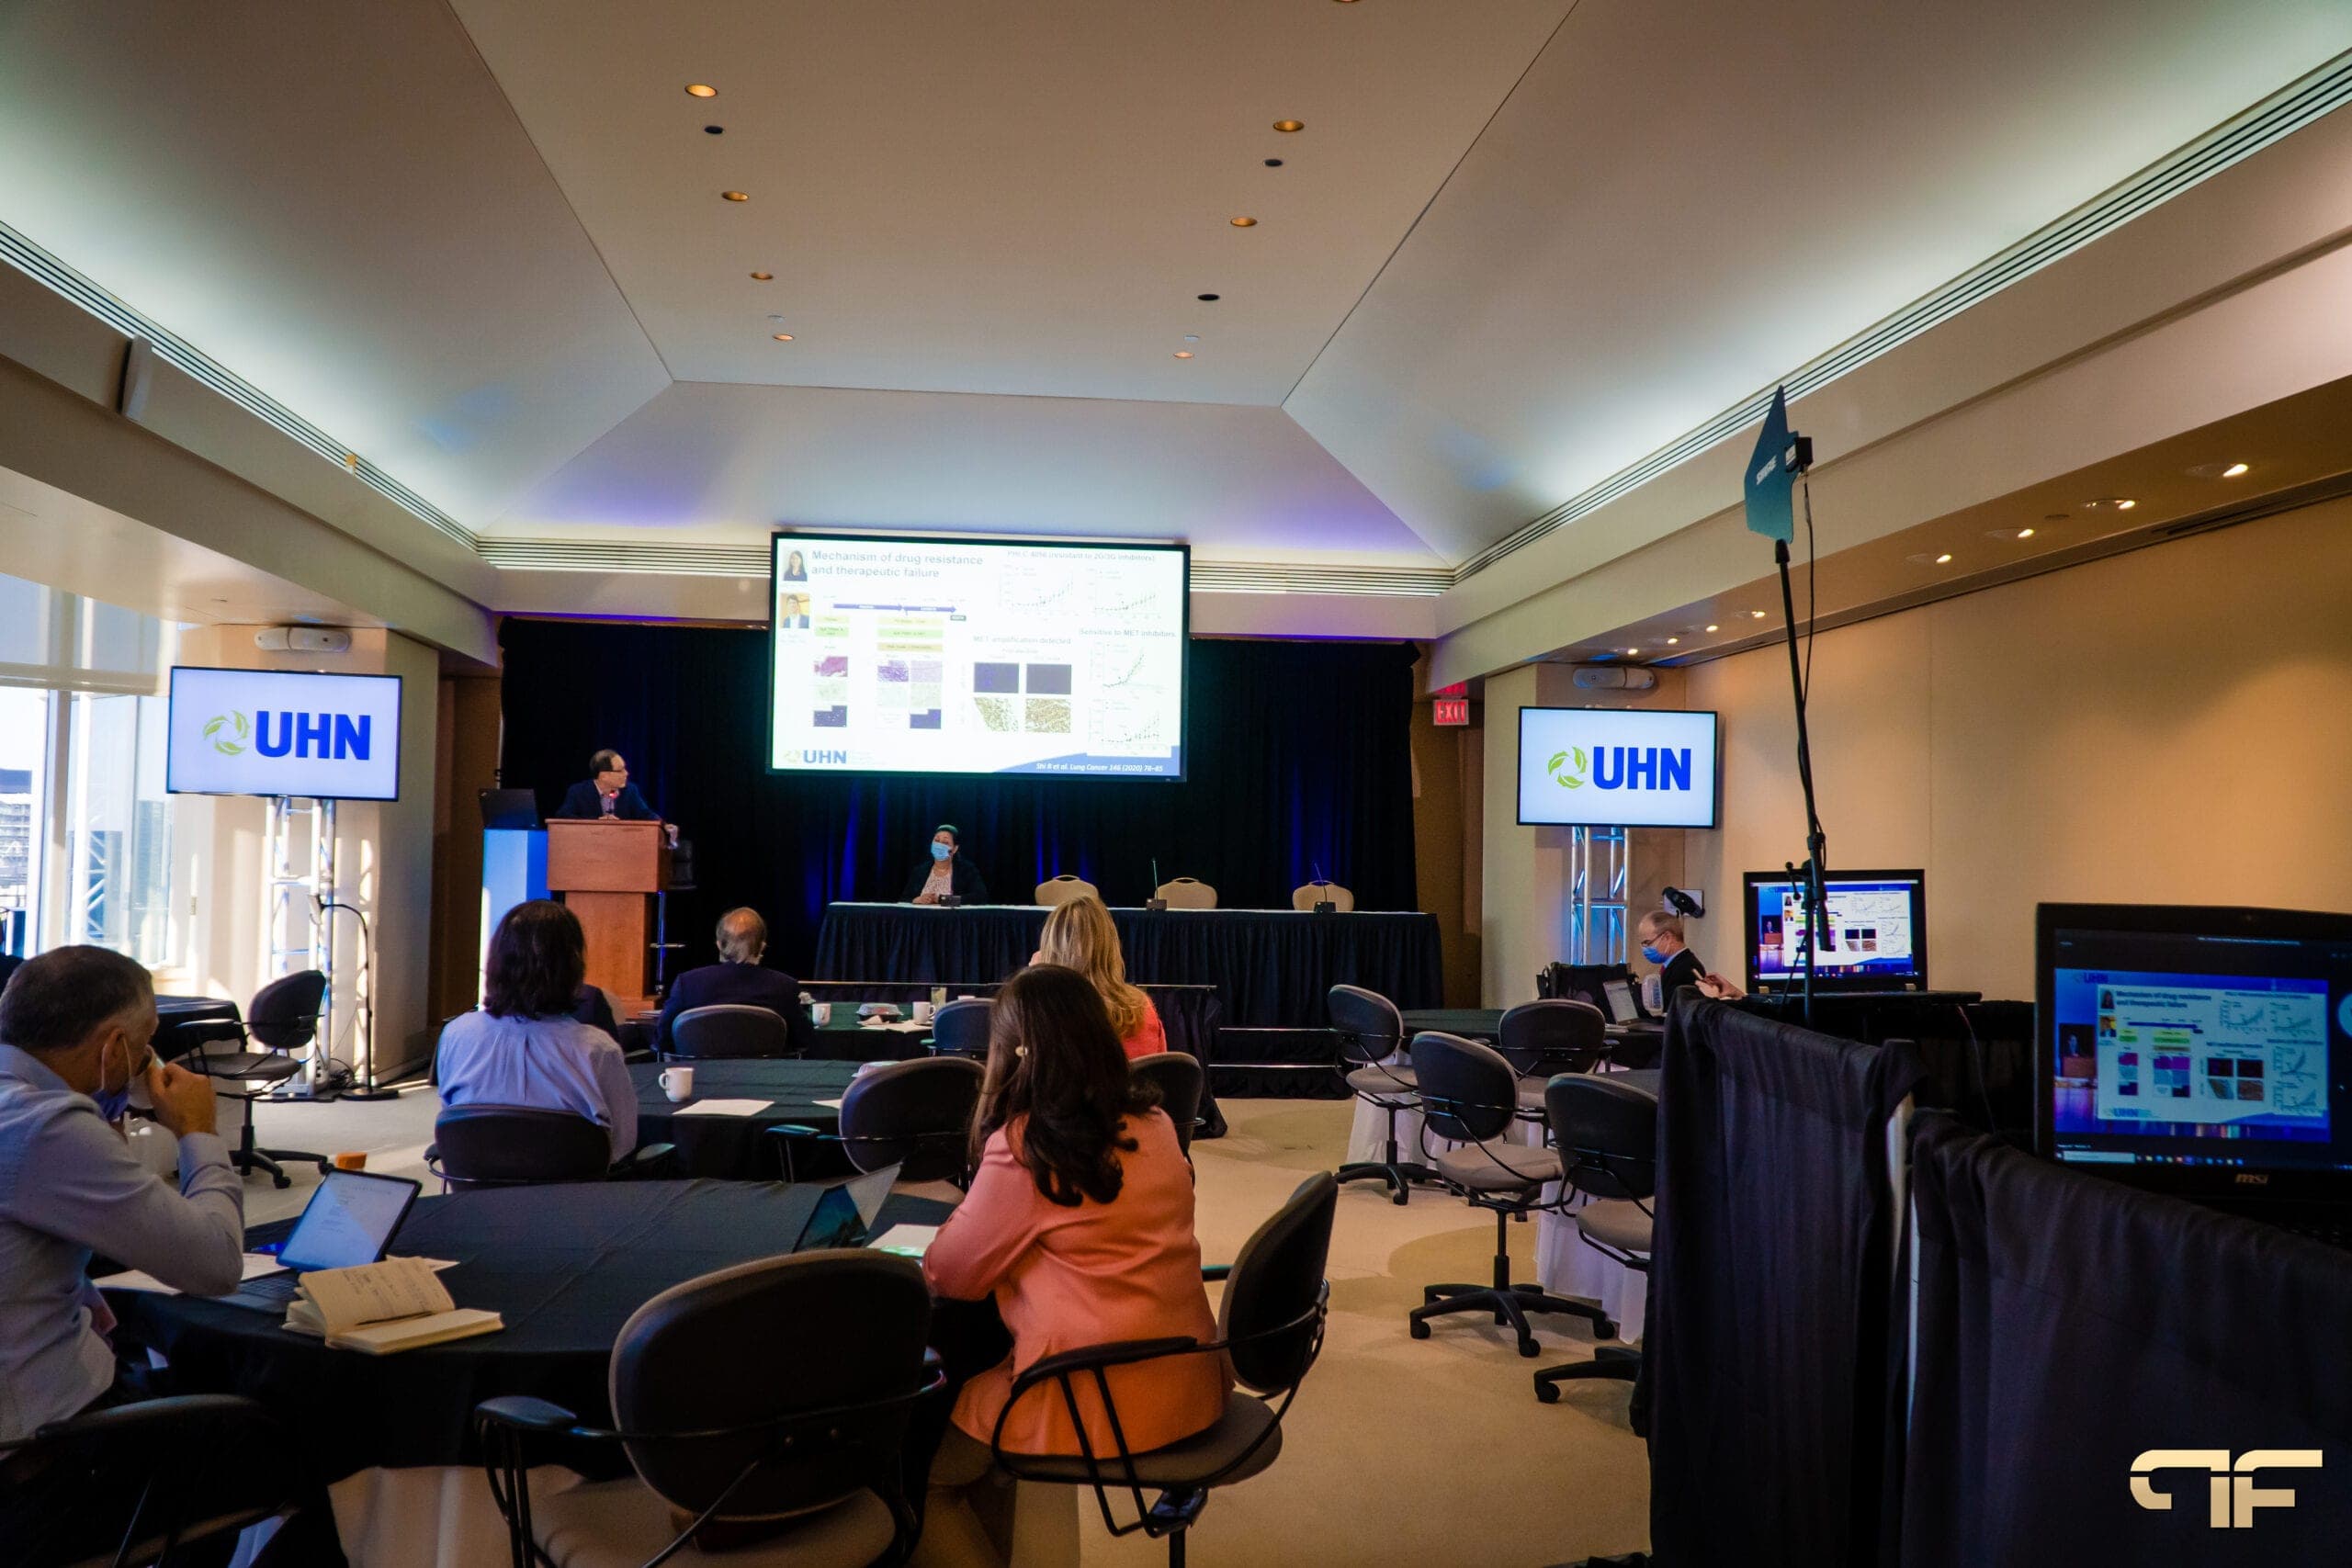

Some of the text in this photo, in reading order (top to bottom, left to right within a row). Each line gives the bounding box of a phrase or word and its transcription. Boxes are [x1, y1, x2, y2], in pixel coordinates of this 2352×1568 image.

[811, 550, 984, 565] Mechanism of drug resistance
[811, 565, 940, 579] and therapeutic failure
[1437, 701, 1466, 723] EXIT
[254, 710, 371, 761] UHN
[802, 750, 847, 764] UHN
[1069, 763, 1086, 773] Lung
[1592, 746, 1691, 791] UHN
